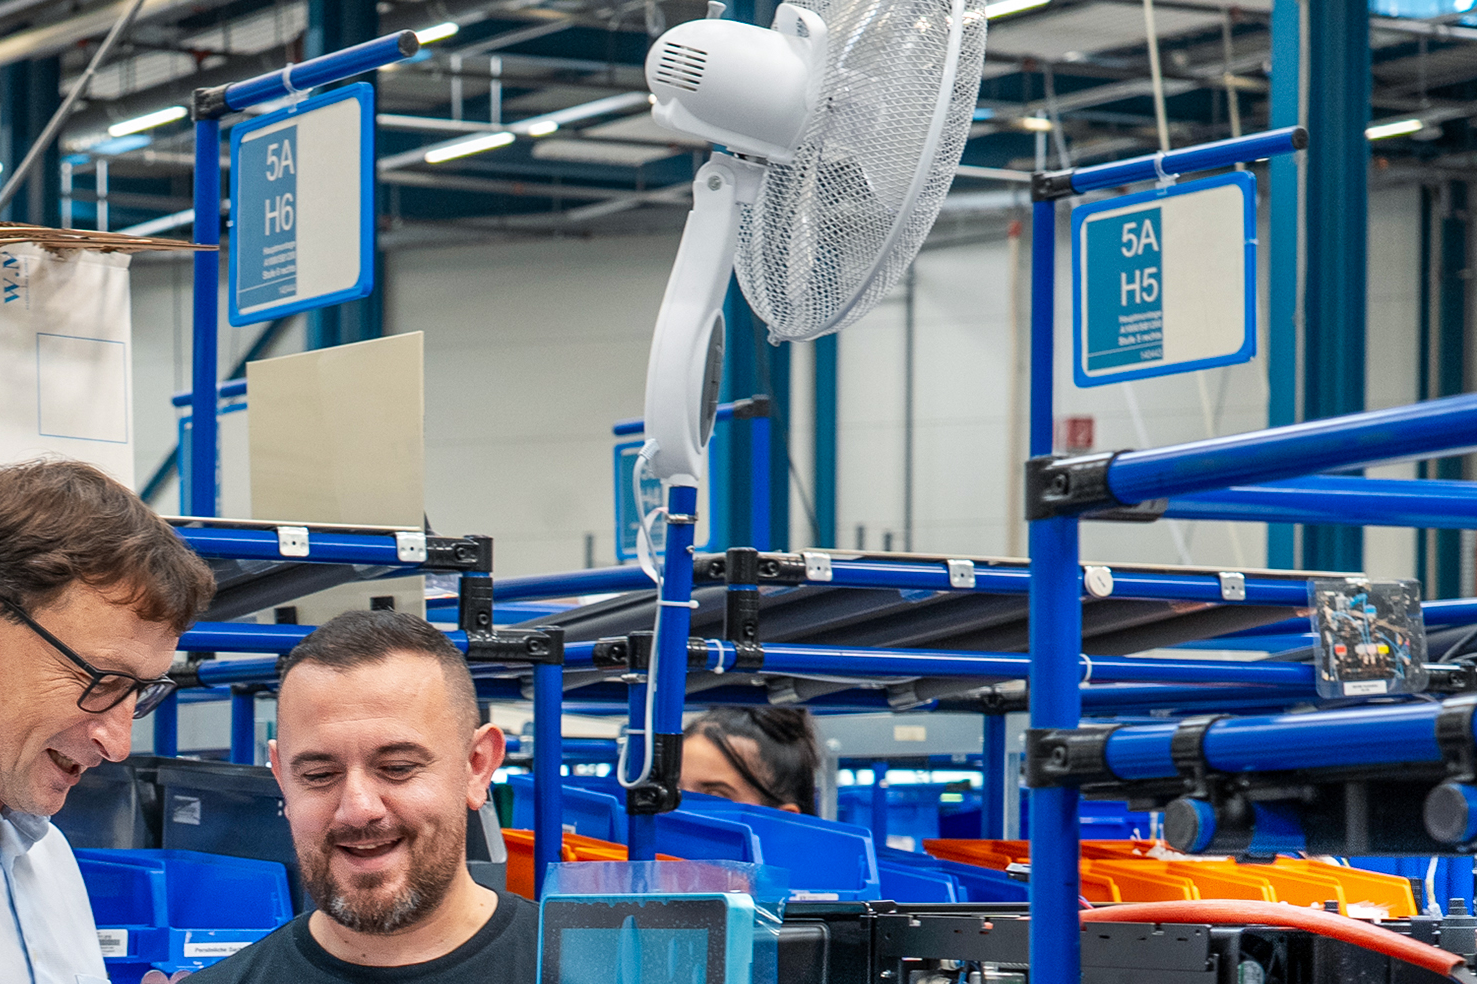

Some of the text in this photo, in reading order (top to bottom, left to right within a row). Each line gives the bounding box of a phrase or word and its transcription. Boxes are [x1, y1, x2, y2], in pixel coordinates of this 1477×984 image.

[266, 139, 295, 181] 5A
[264, 193, 294, 236] H6
[1121, 219, 1159, 257] 5A
[1120, 267, 1159, 306] H5
